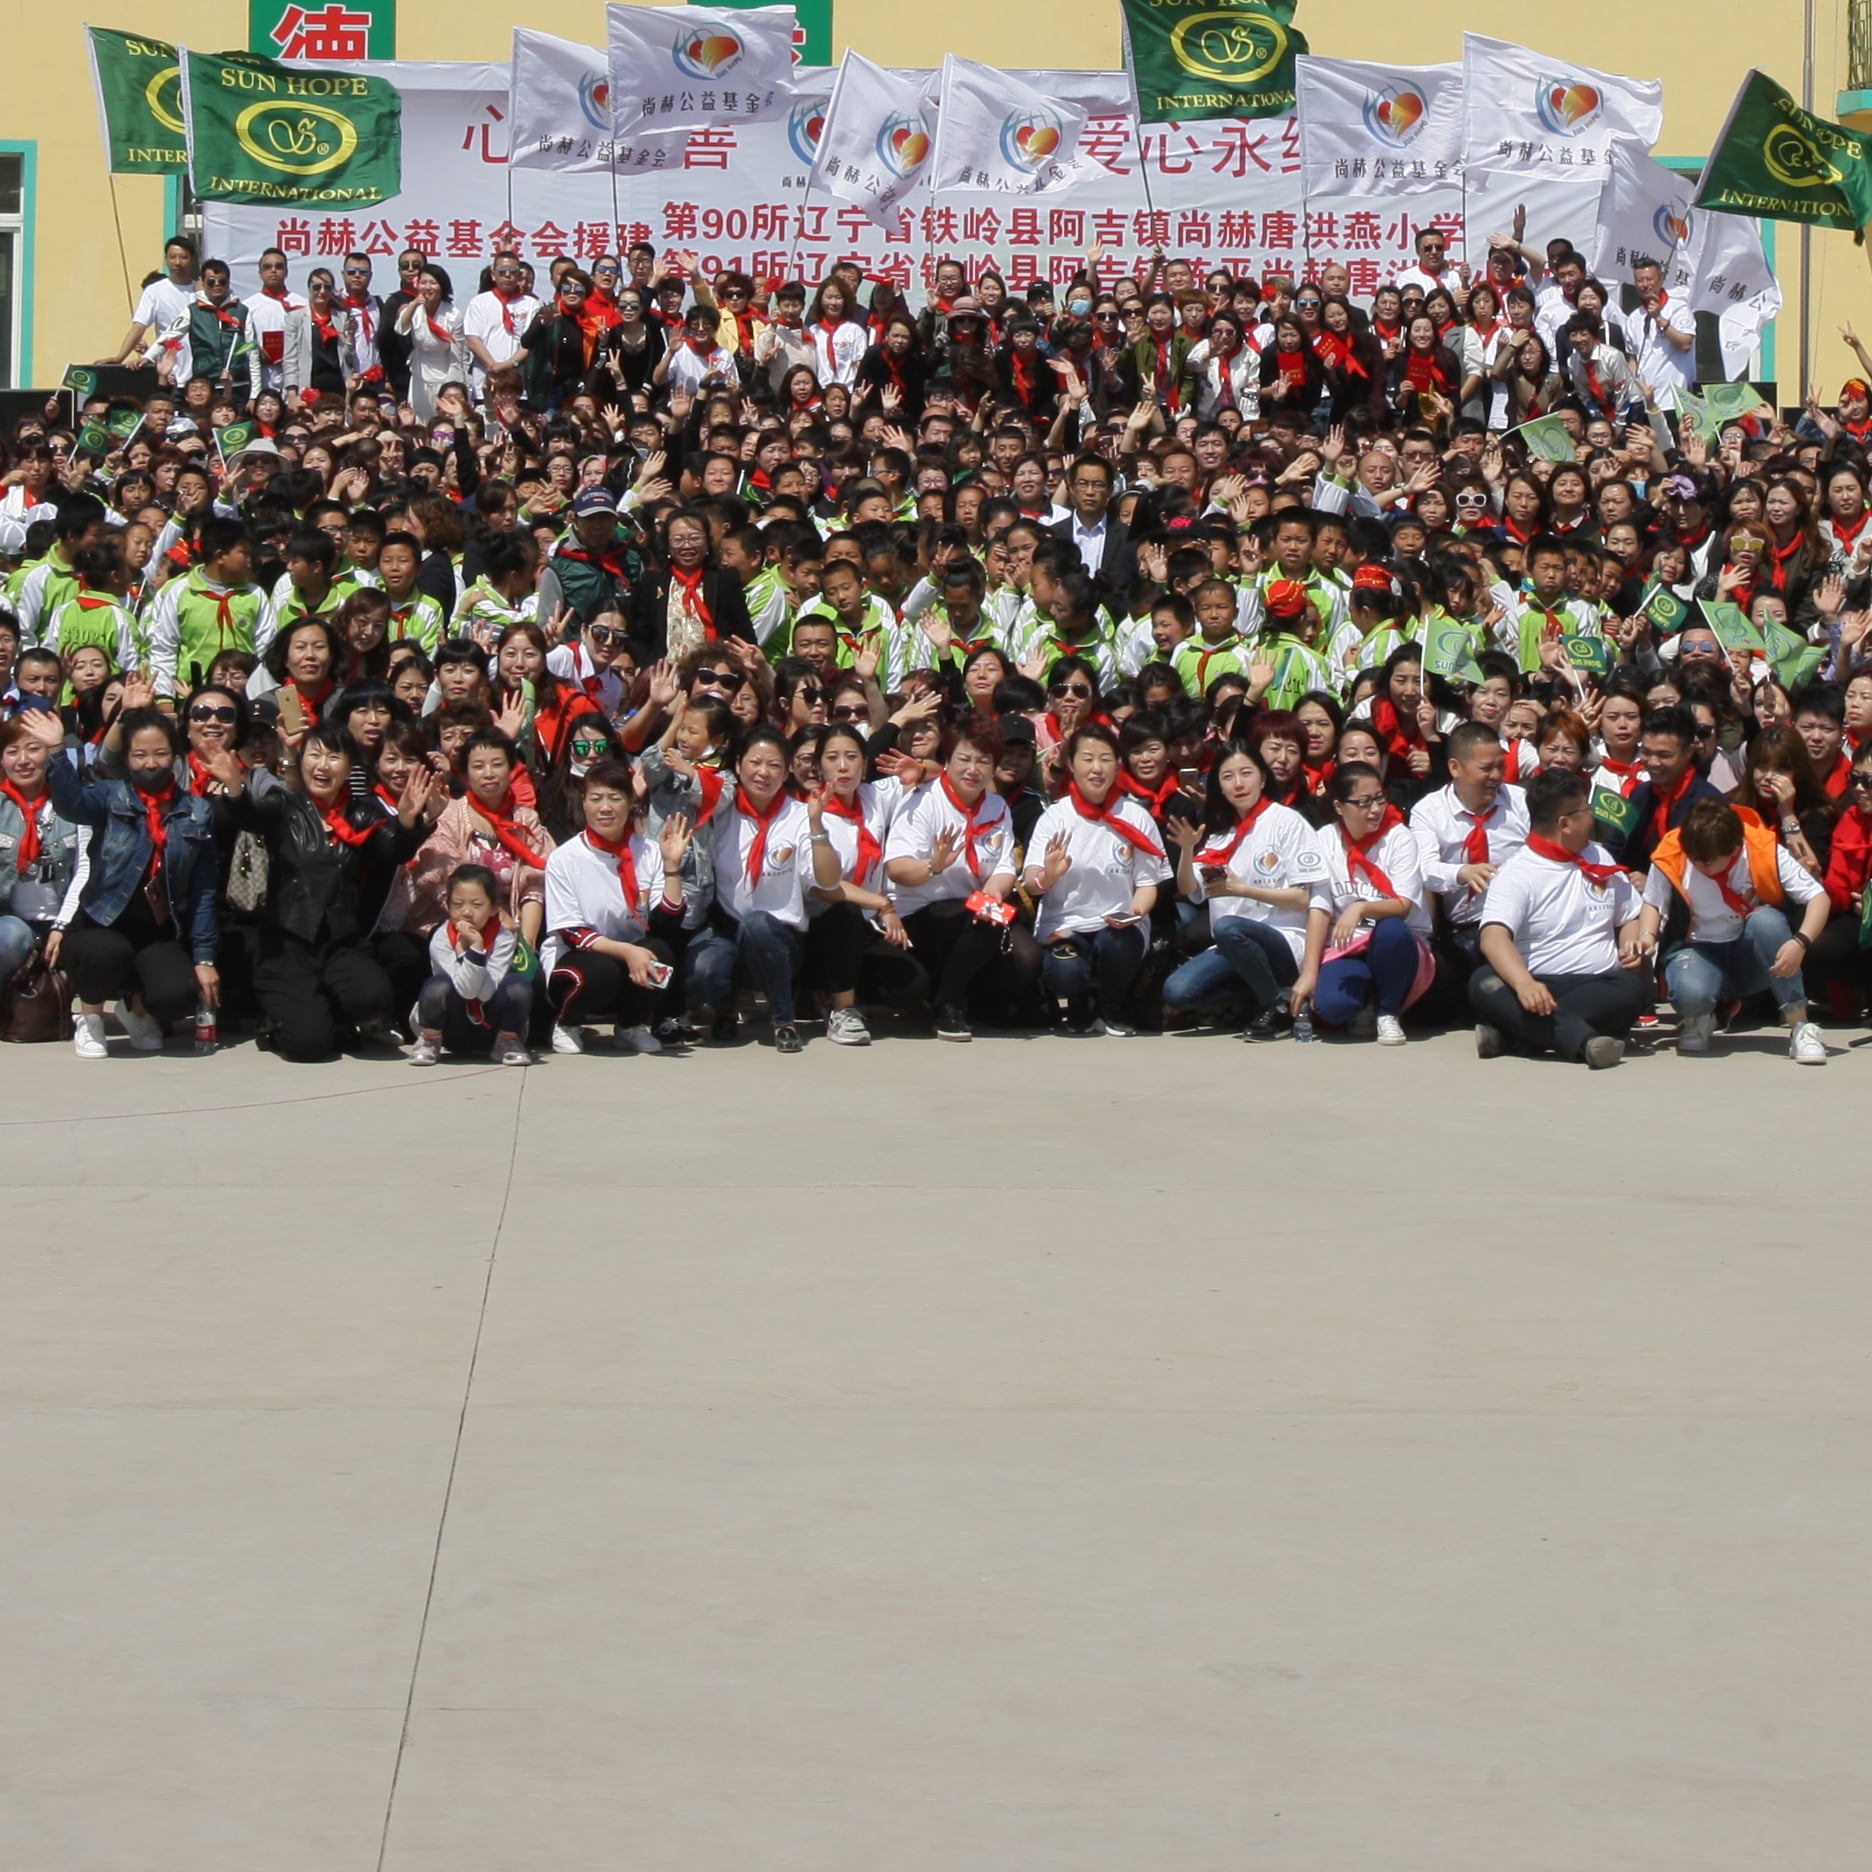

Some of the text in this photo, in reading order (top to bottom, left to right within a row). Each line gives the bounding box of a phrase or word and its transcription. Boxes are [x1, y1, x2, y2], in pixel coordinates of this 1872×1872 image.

[220, 67, 369, 96] SUN HOPE
[1156, 91, 1297, 111] INTERNATIONA
[128, 148, 188, 164] INTER
[537, 134, 667, 167] 尚赫公益基金会
[1334, 158, 1468, 179] 尚赫公益基金会
[208, 176, 383, 201] INTERNATIONAL
[1718, 188, 1853, 216] INTERNATION
[276, 216, 654, 260] 尚赫公益基金会援建
